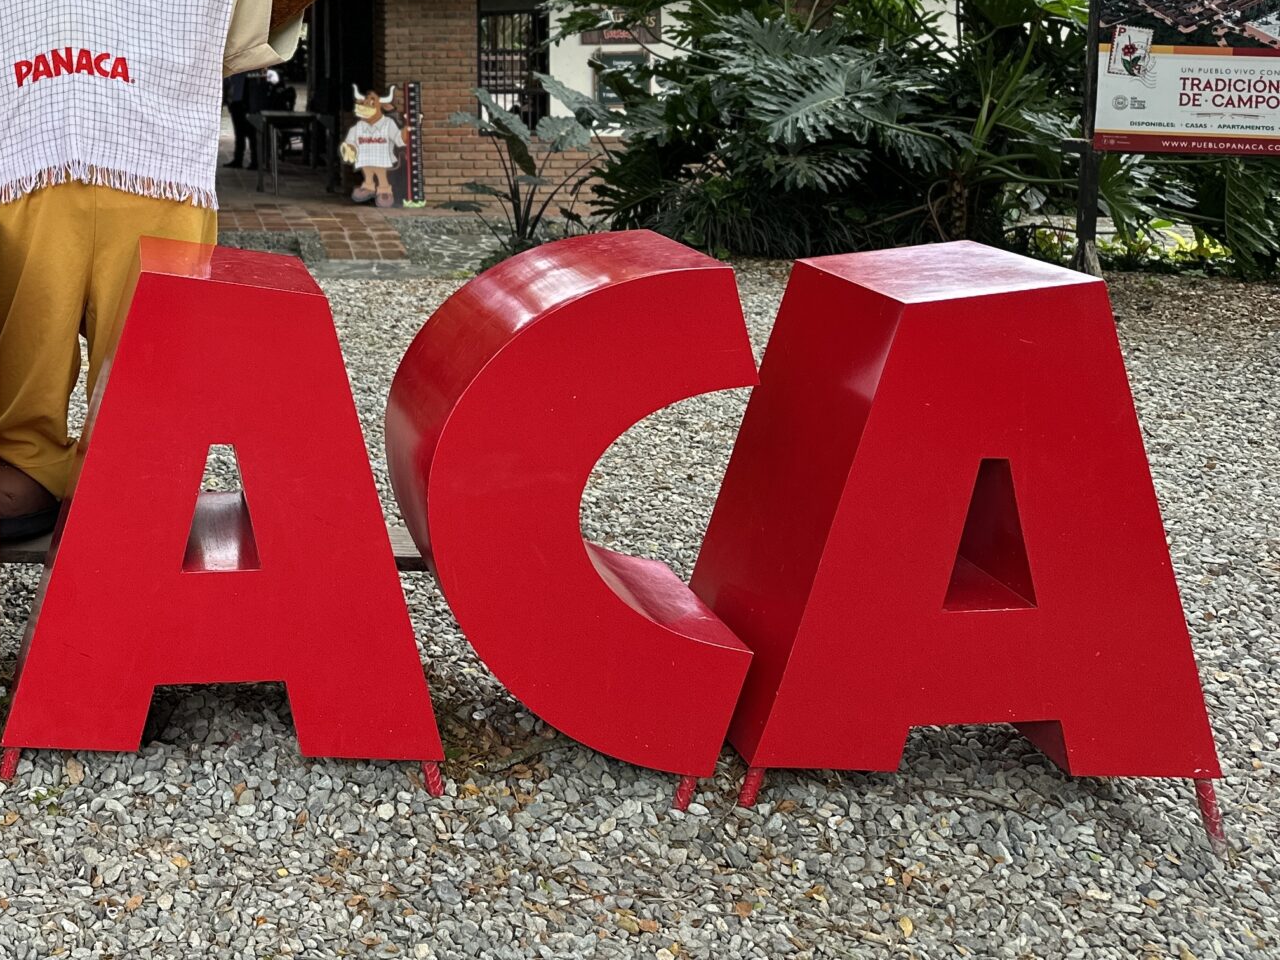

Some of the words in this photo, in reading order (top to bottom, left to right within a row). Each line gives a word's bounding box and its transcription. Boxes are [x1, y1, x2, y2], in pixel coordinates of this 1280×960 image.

[14, 47, 130, 88] PANACA
[1198, 67, 1231, 75] PUEBLO
[1180, 76, 1280, 94] TRADICIÓN
[1179, 93, 1202, 107] DE
[1212, 94, 1280, 109] CAMPO
[1217, 123, 1275, 131] APARTAMENTOS
